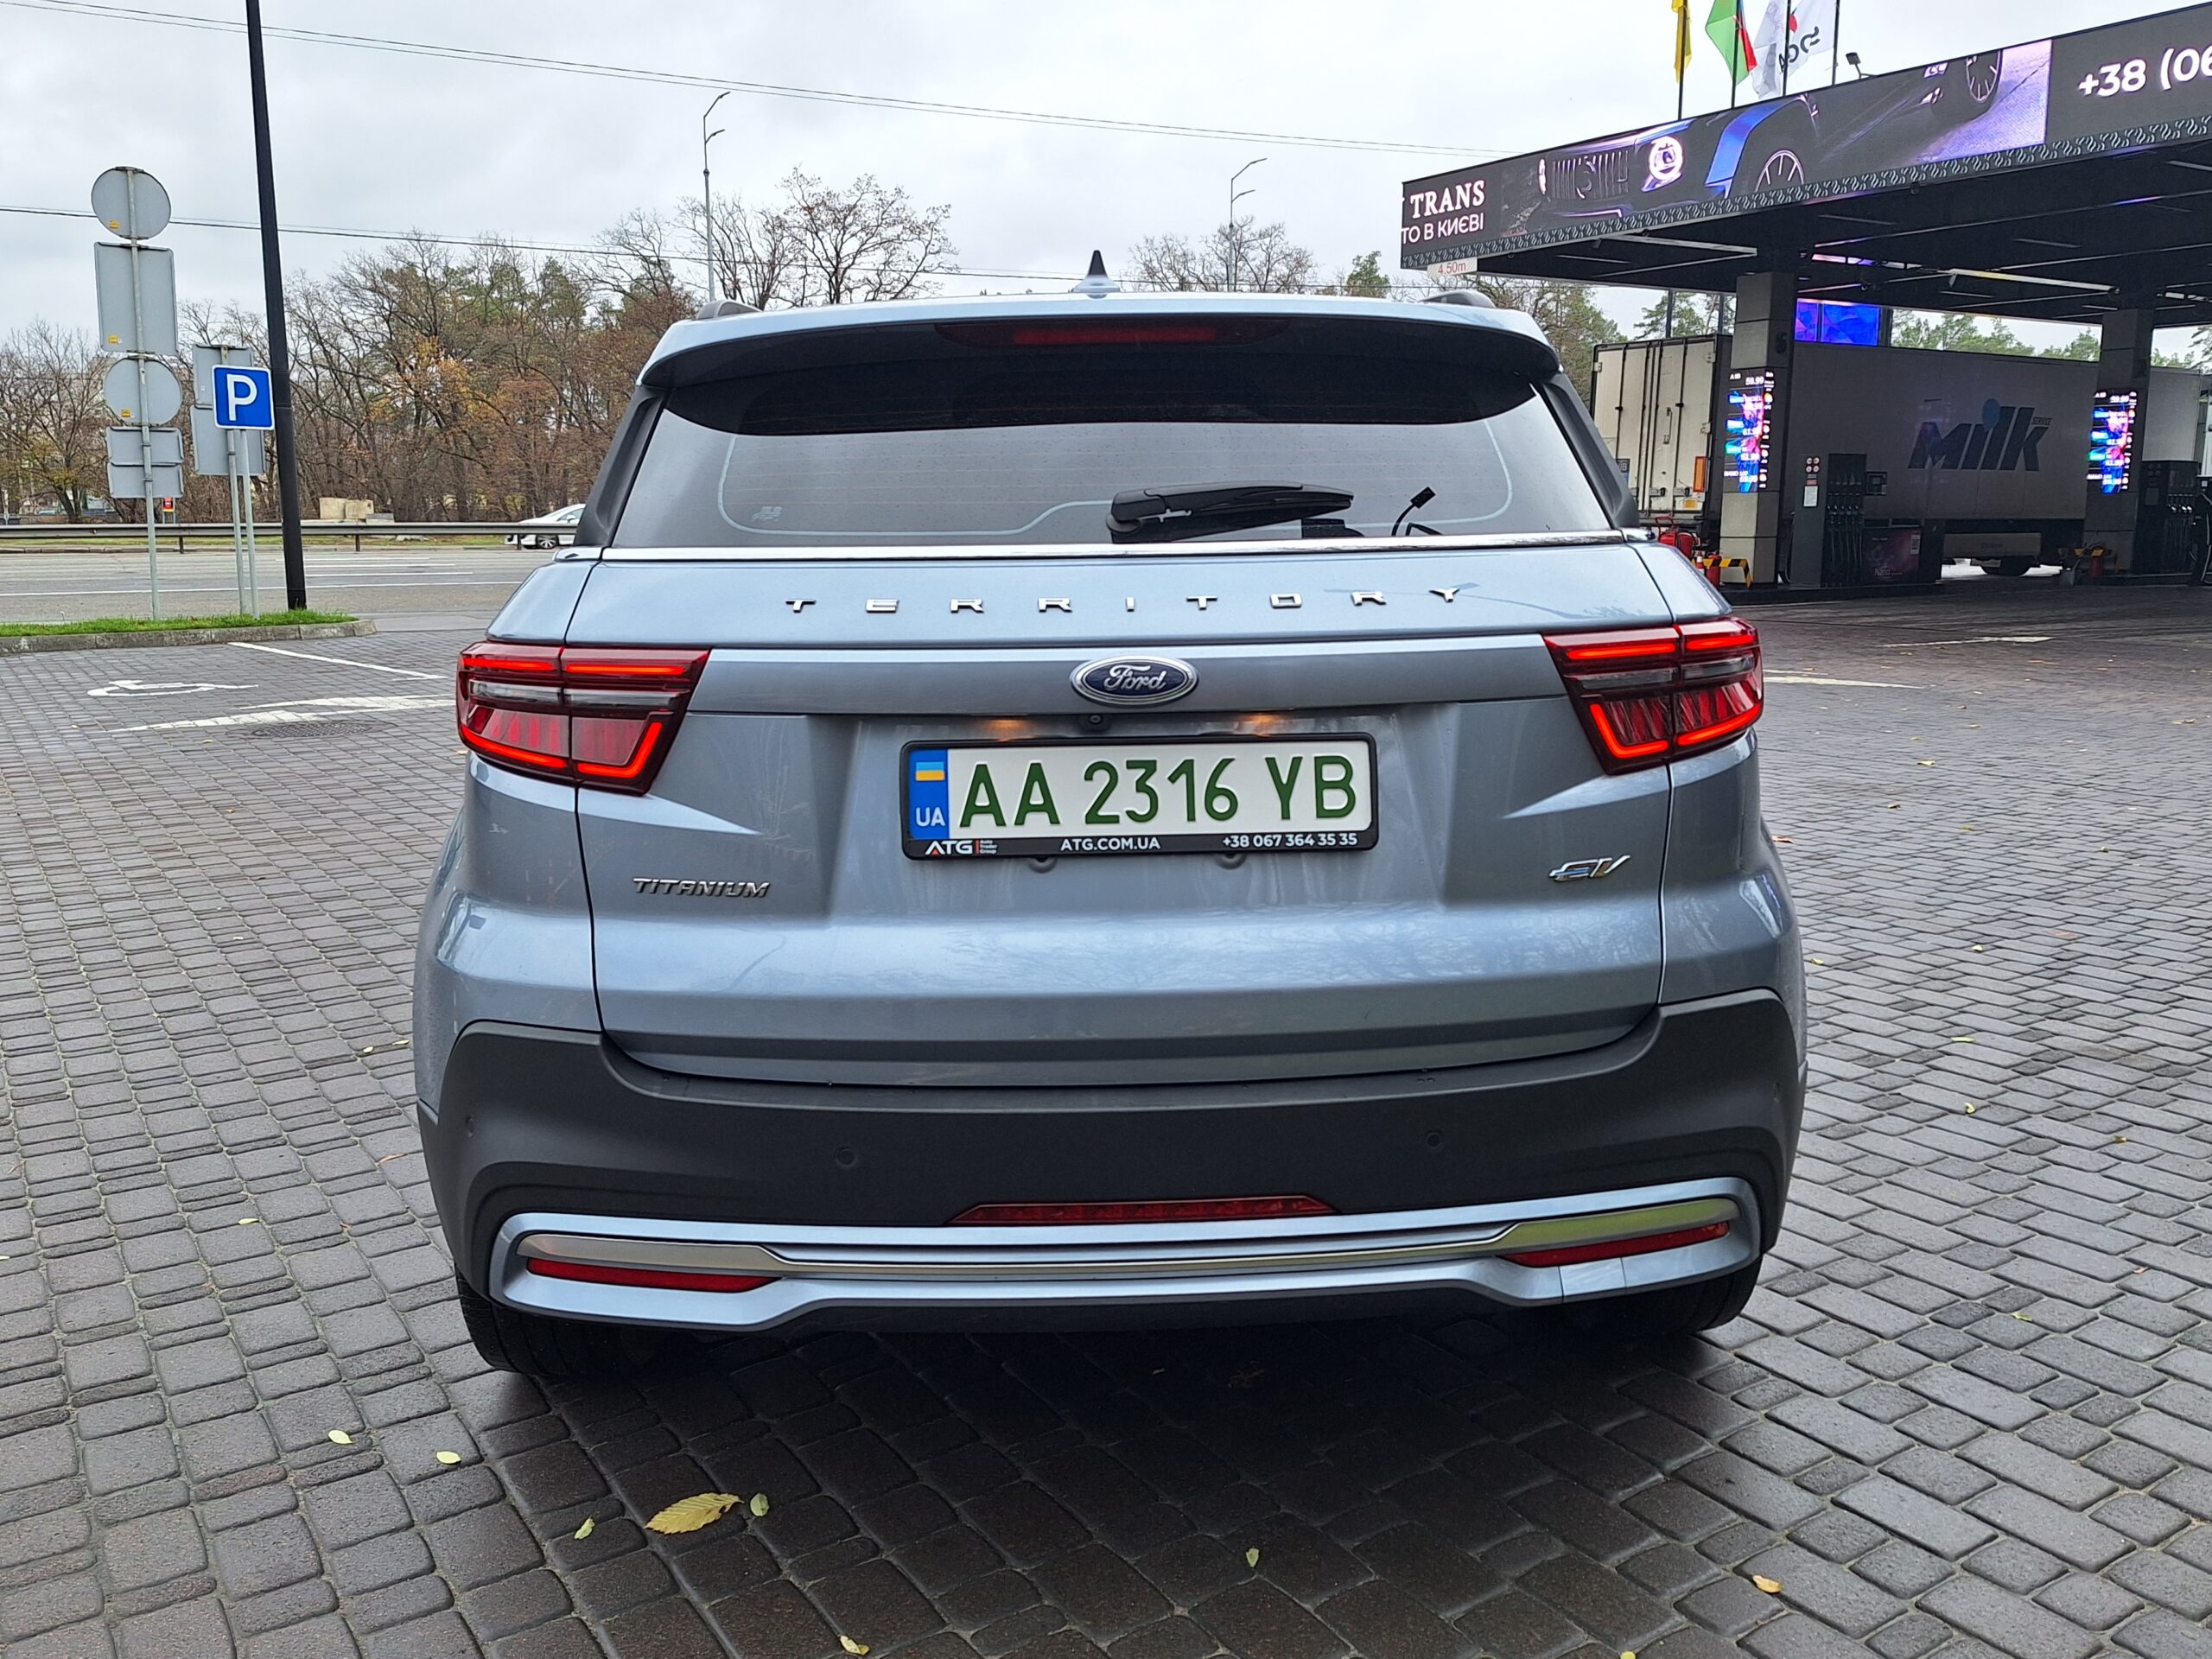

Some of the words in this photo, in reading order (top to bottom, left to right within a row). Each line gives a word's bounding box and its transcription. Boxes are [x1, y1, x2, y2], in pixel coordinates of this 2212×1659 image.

[2077, 58, 2147, 97] +38
[1410, 179, 1485, 219] TRANS
[1423, 222, 1434, 241] В
[1437, 213, 1484, 238] КИЄВІ
[1438, 261, 1467, 275] 4.50m
[1745, 377, 1764, 385] 59.99
[226, 373, 258, 422] P
[785, 588, 1460, 613] TERRITORY
[1103, 664, 1167, 690] Ford
[959, 762, 1061, 828] AA
[1084, 758, 1238, 824] 2316
[1264, 755, 1357, 820] YB
[916, 807, 946, 827] UA
[925, 840, 973, 855] ATG
[1060, 836, 1160, 851] ATG.COM.UA
[1223, 835, 1249, 848] +38
[1253, 834, 1282, 848] 067
[1285, 834, 1315, 847] 364
[1318, 833, 1337, 846] 35
[1339, 833, 1357, 846] 35
[632, 878, 770, 899] TITANIUM
